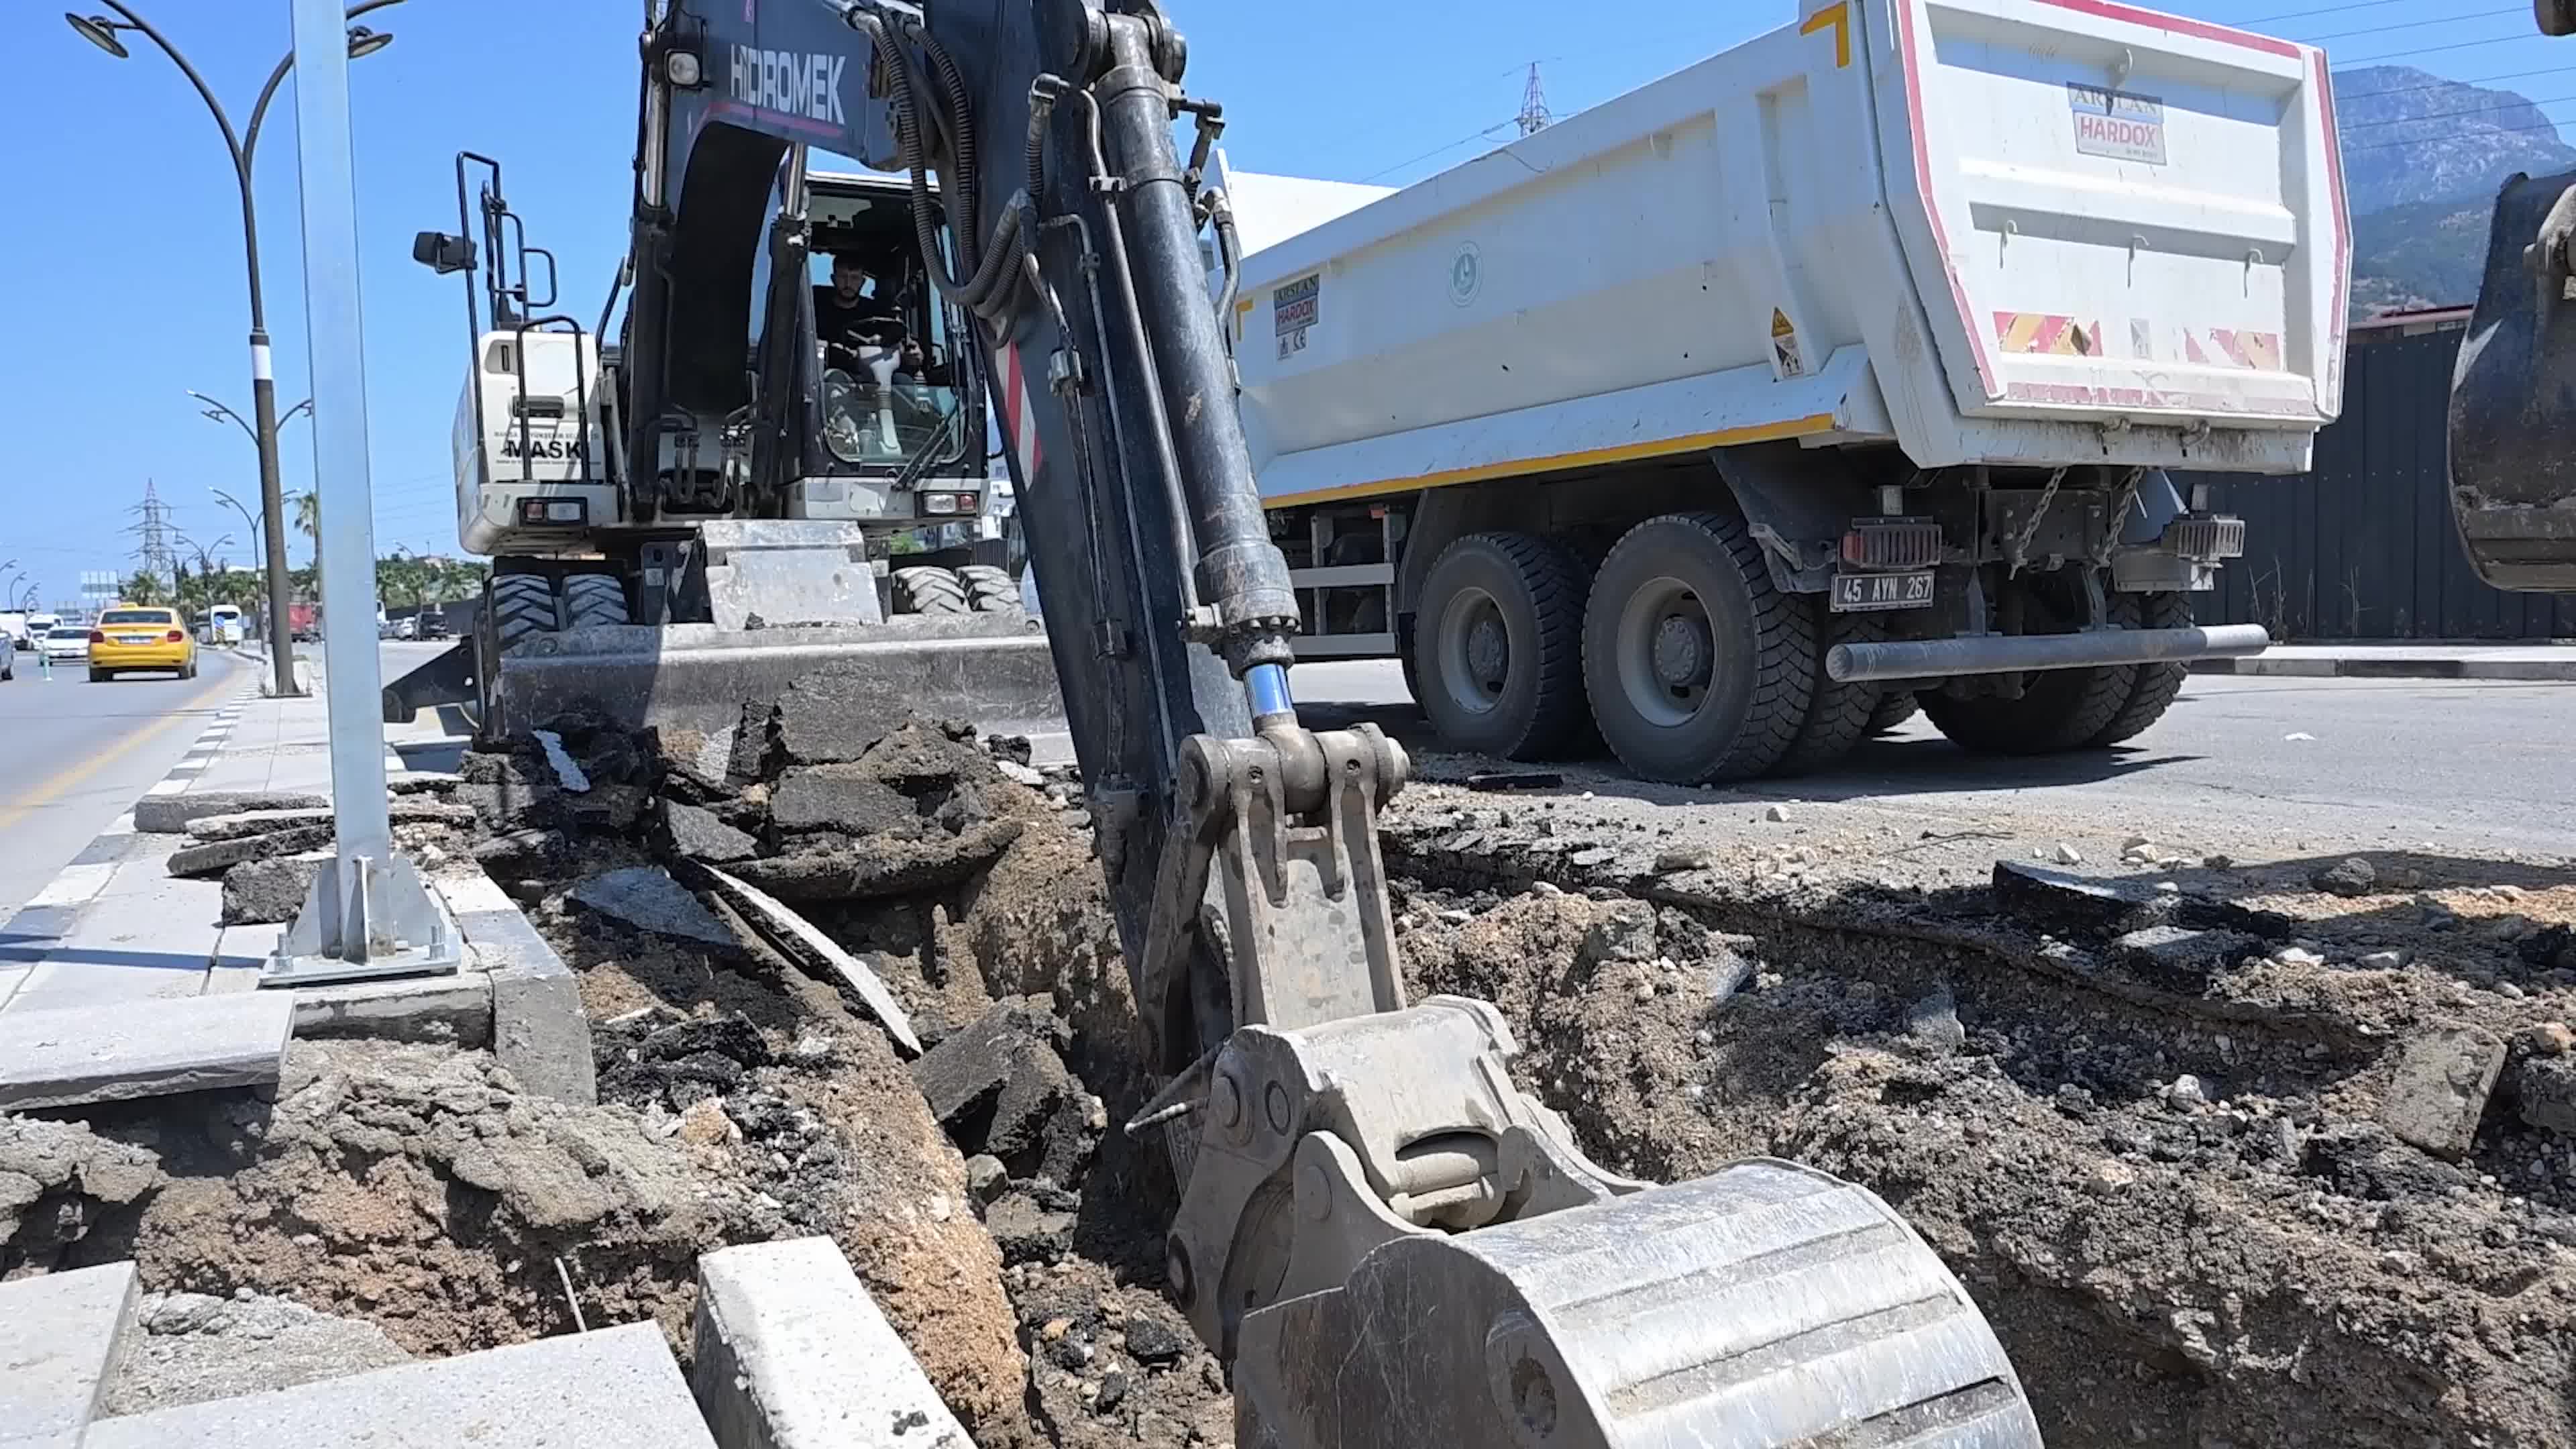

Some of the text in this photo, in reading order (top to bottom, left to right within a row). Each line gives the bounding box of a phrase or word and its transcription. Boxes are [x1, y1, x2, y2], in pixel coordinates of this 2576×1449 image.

[2074, 85, 2157, 116] ARLAN
[2080, 115, 2159, 148] HARDOX
[1277, 300, 1315, 323] HARDOX
[1843, 575, 1932, 602] 45 AYN 267
